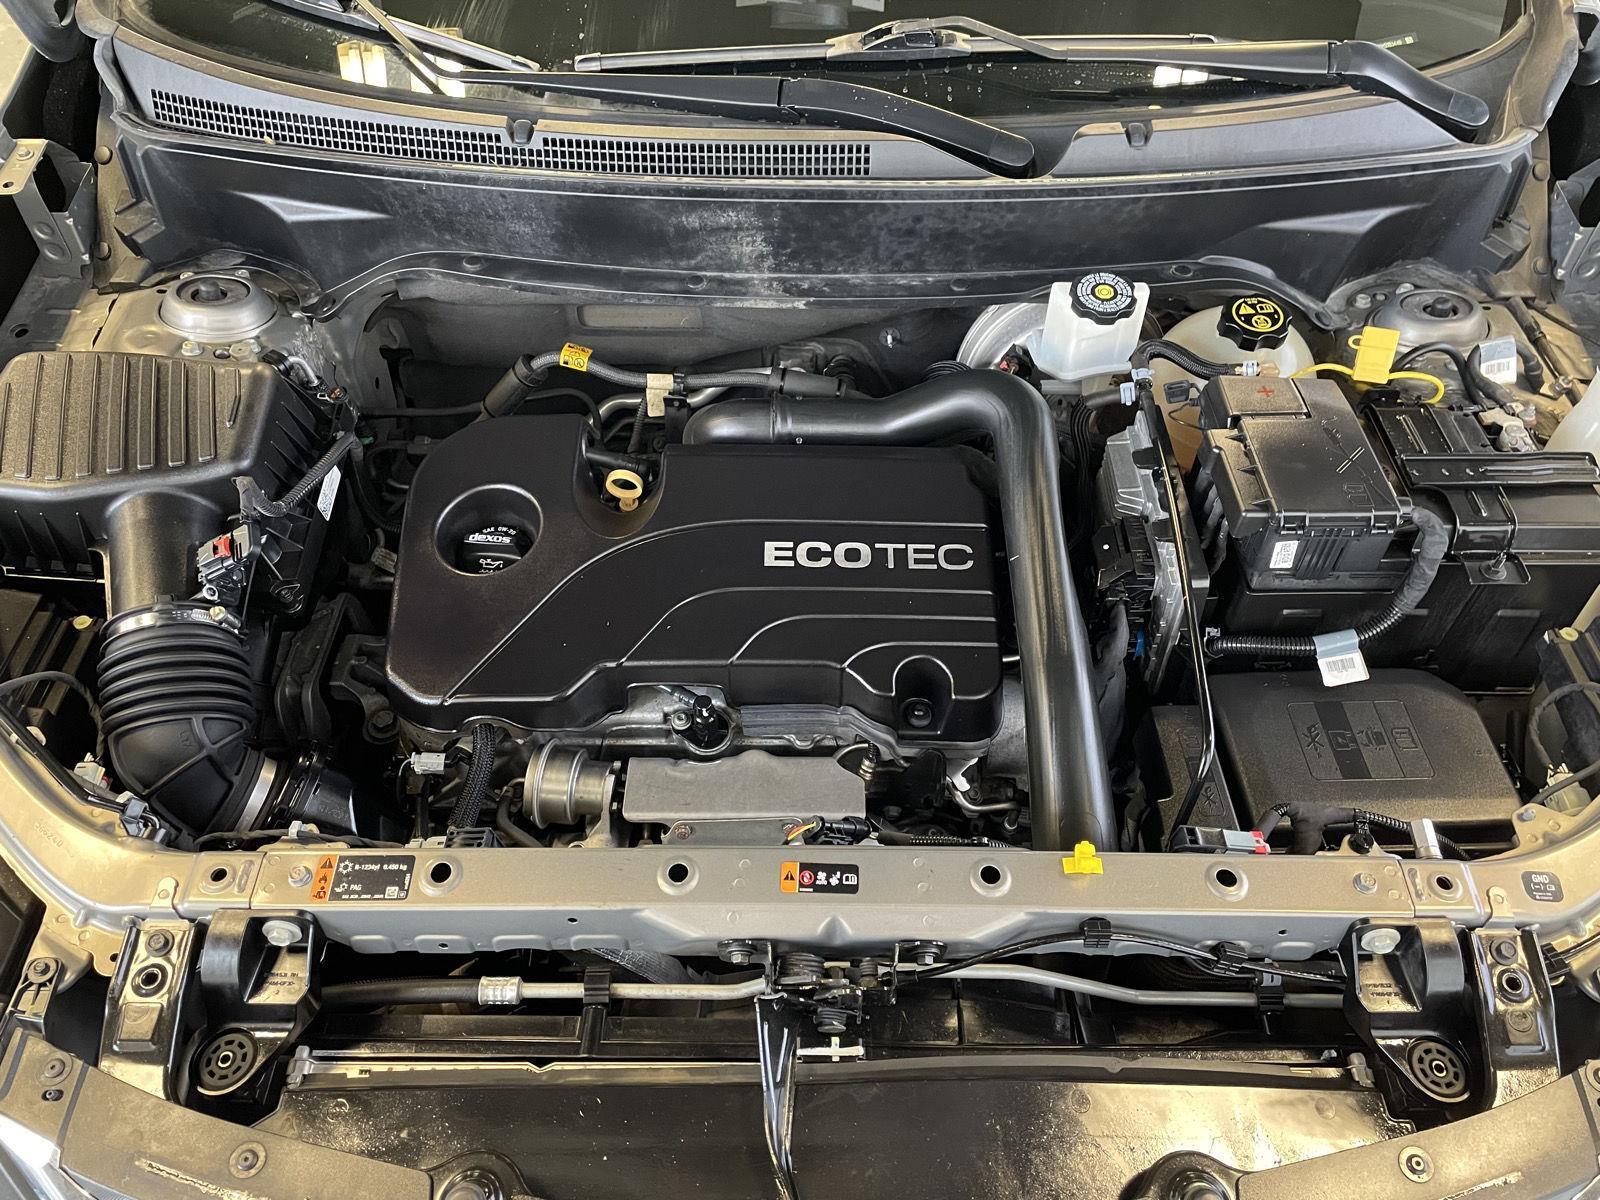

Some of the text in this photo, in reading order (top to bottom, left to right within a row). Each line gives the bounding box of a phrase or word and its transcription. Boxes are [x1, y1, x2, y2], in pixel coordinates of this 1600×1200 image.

[469, 533, 512, 544] dexos
[764, 541, 974, 570] ECOTEC
[1531, 874, 1550, 883] GND
